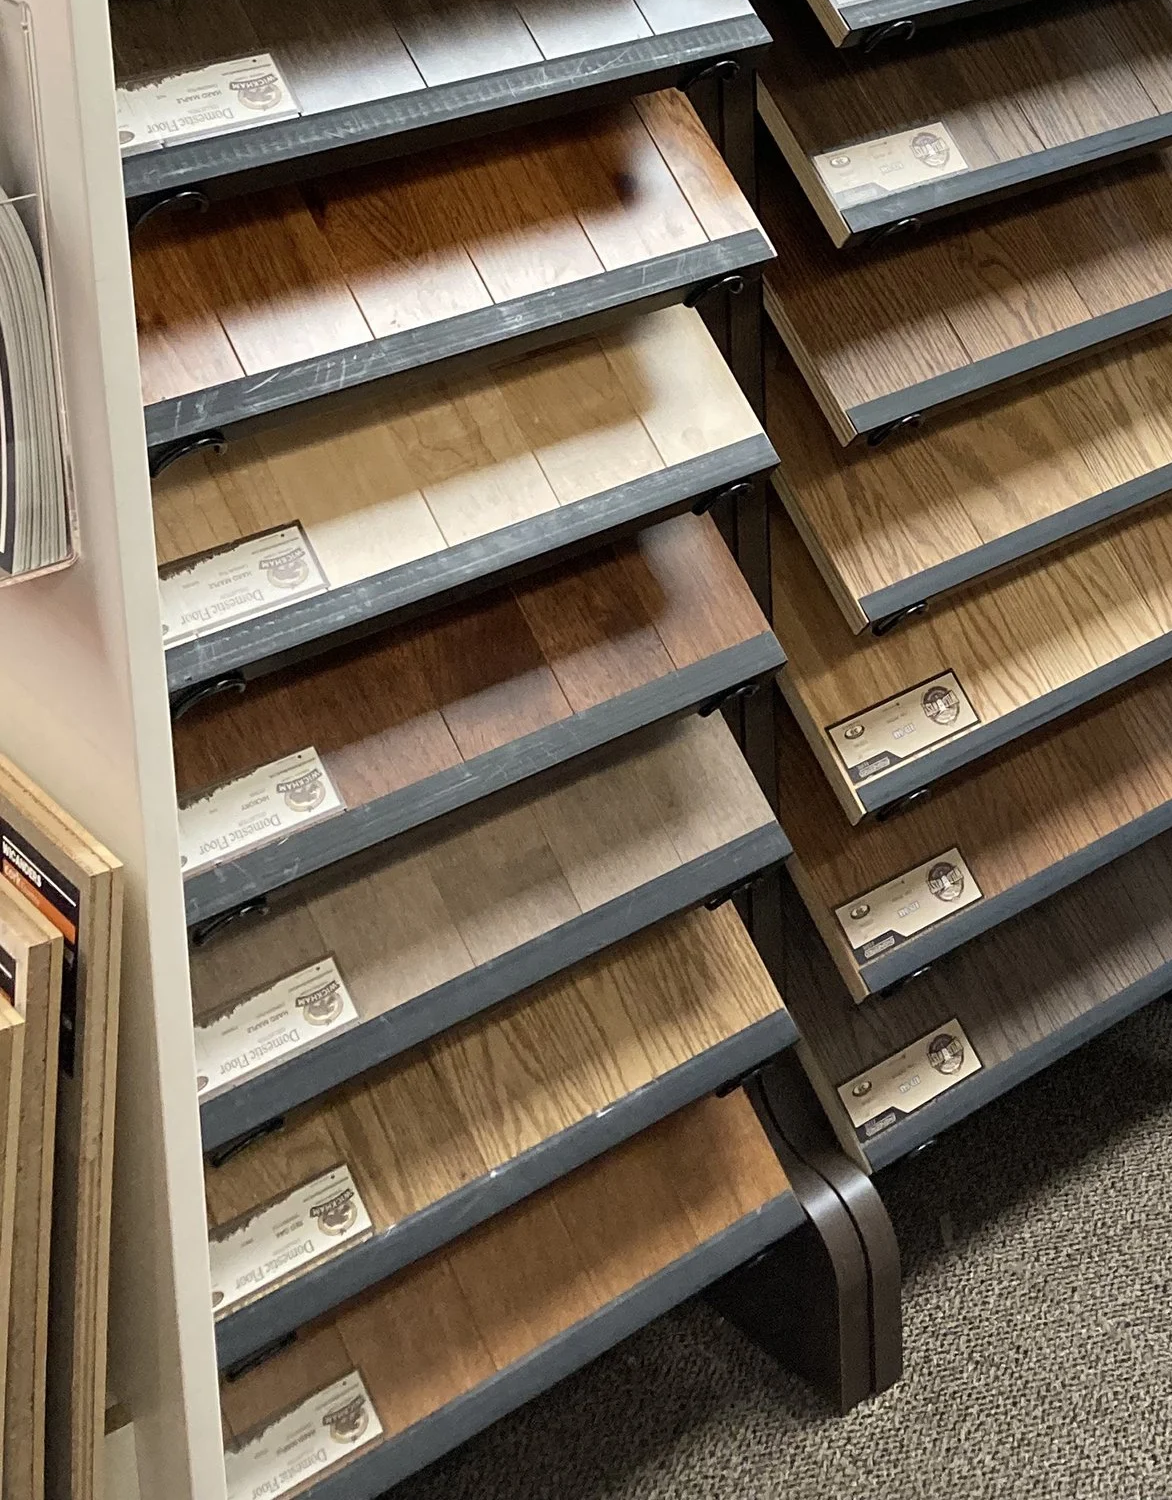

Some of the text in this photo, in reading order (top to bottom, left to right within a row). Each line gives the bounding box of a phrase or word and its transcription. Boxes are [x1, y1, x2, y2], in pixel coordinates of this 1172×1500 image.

[231, 75, 275, 90] WICKHAM
[147, 108, 233, 134] Domestic Floor
[181, 589, 264, 626] Domestic Floor
[199, 814, 281, 855] Domestic Floor
[296, 982, 338, 1007] WICKHAM
[220, 1028, 300, 1075] Domestic Floor
